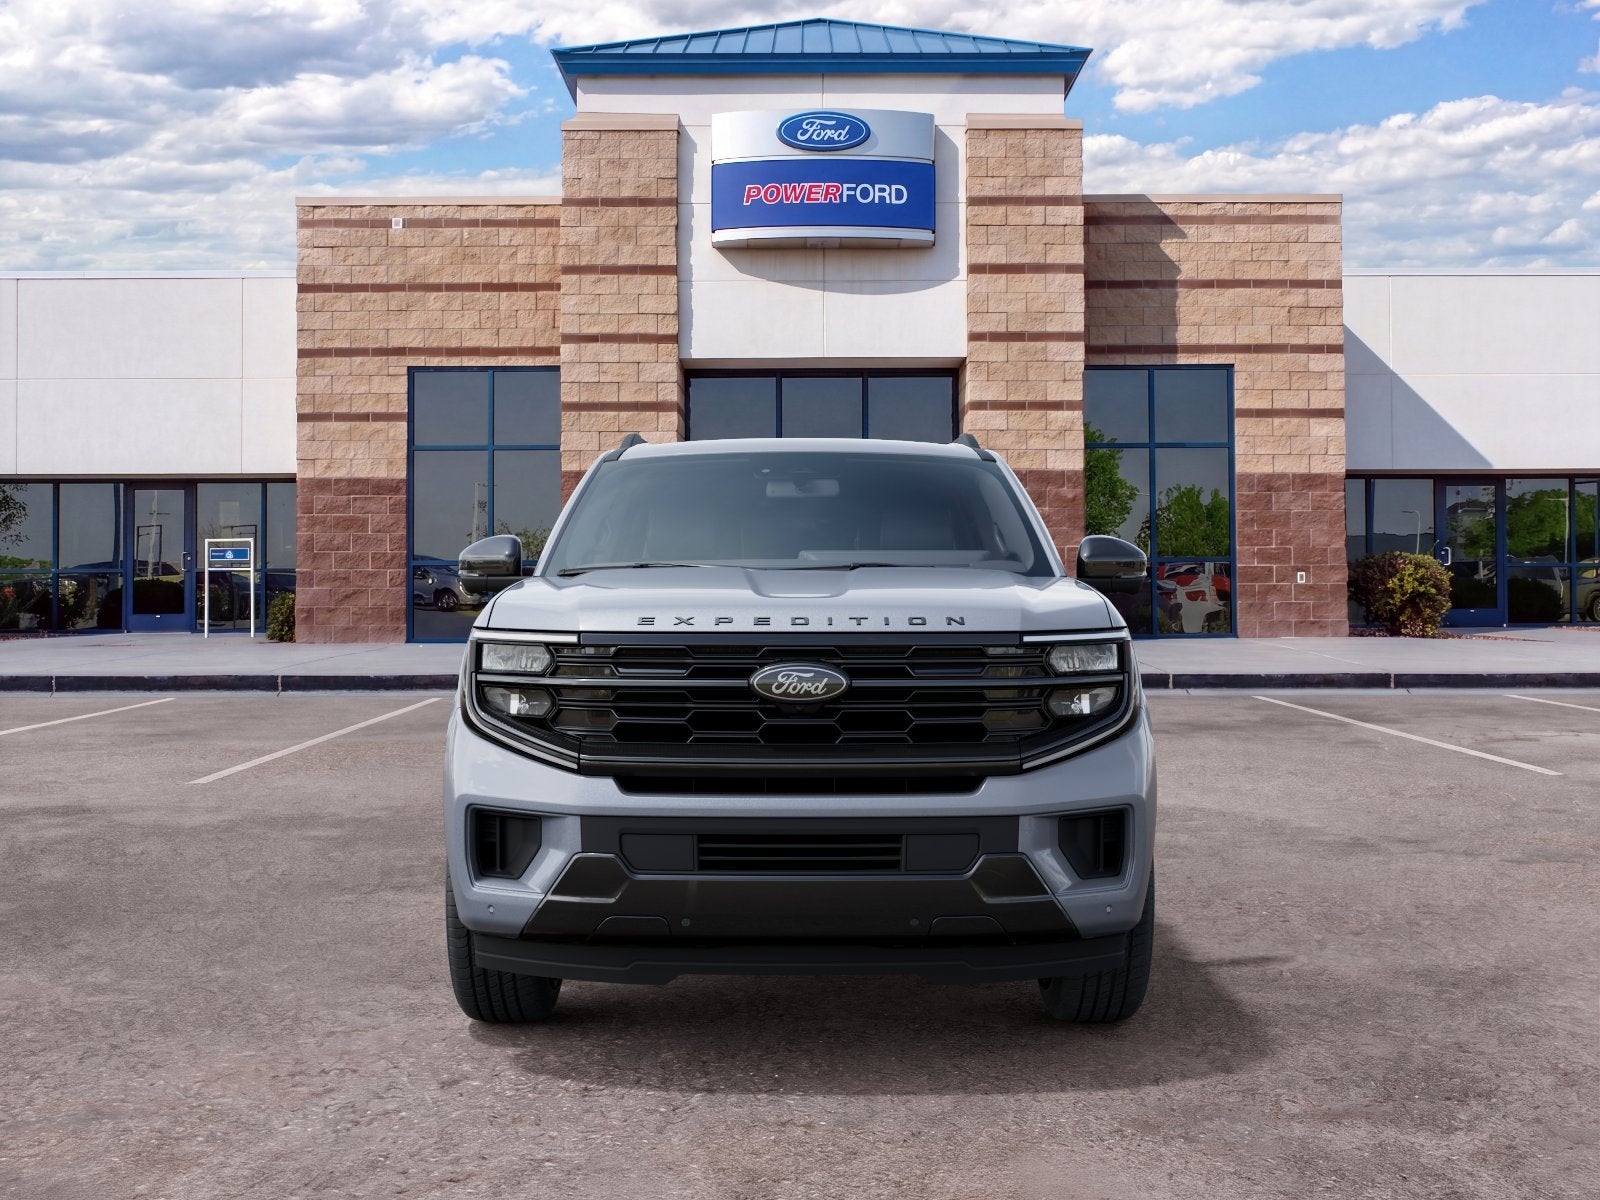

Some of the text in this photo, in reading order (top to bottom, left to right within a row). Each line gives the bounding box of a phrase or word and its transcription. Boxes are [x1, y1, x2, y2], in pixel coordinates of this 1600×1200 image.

[797, 118, 850, 141] Ford
[637, 616, 966, 626] EXPEDITION
[771, 671, 827, 695] Ford
